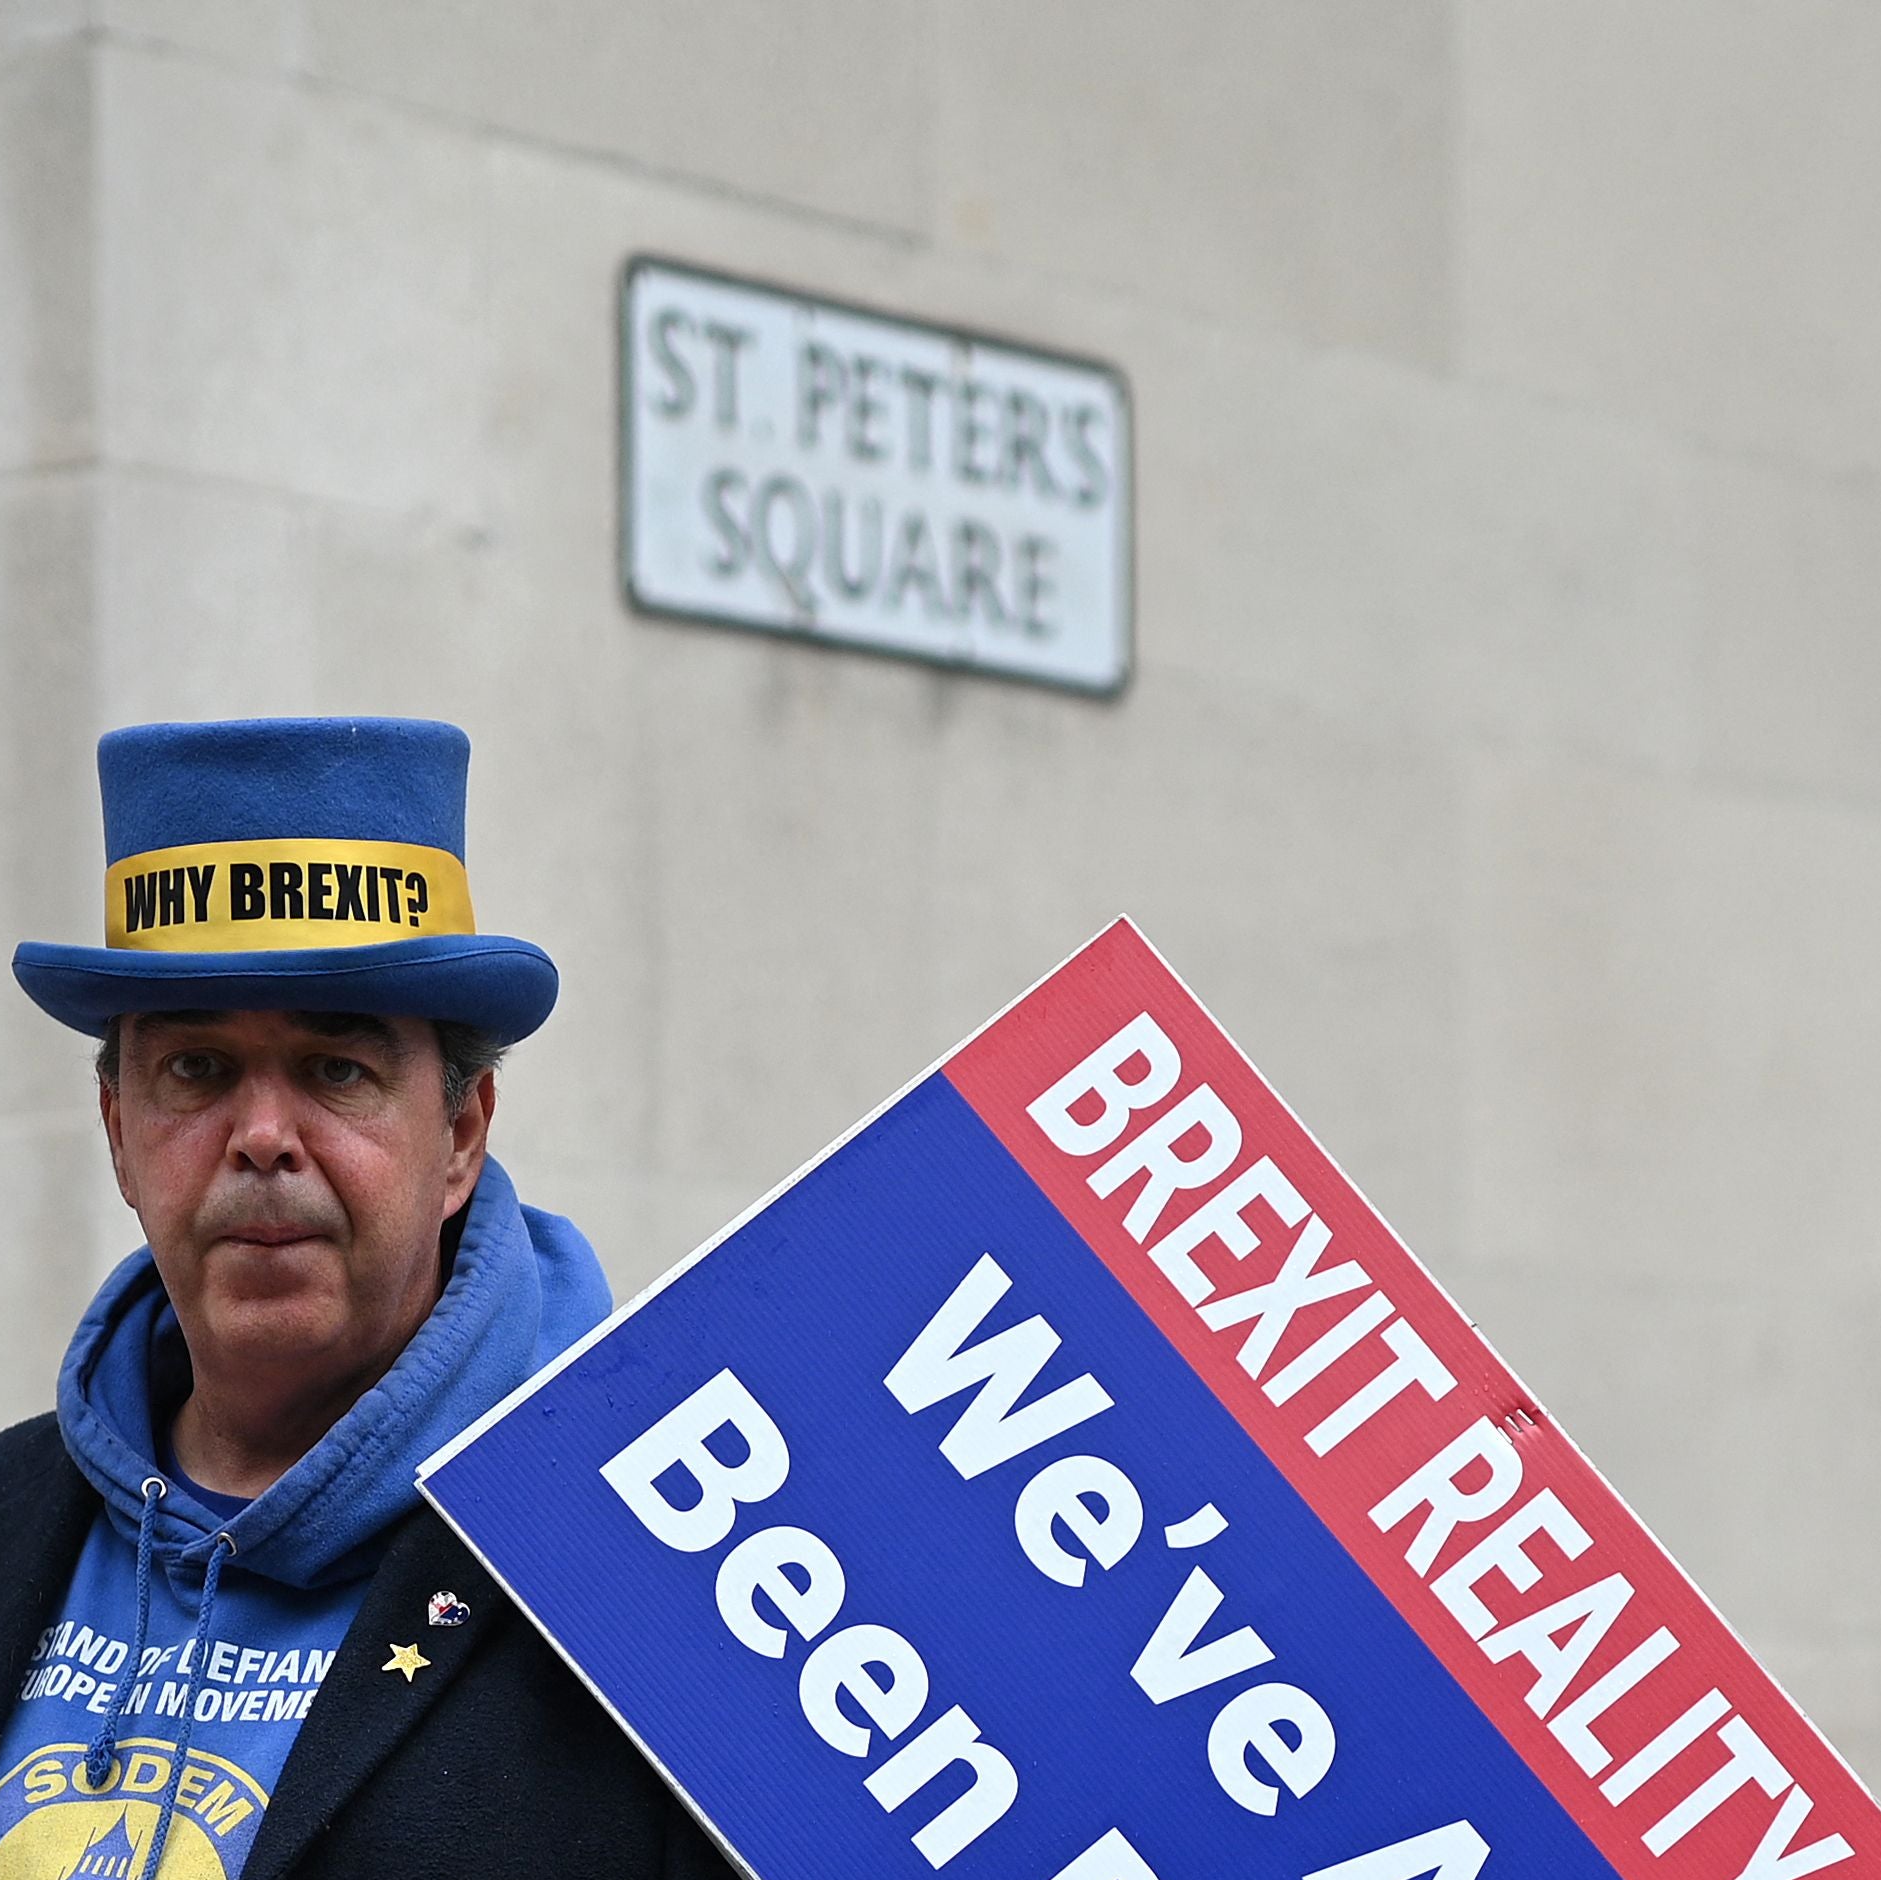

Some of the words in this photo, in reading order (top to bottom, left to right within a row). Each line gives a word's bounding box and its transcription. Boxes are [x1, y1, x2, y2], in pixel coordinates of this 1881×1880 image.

[795, 338, 1111, 512] PETERS
[700, 466, 1056, 641] SQUARE
[124, 864, 216, 933] WHY
[230, 862, 429, 928] BREXIT?
[1025, 1010, 1459, 1458] BREXIT
[598, 1367, 1019, 1871] Been
[23, 1752, 254, 1837] SODEM
